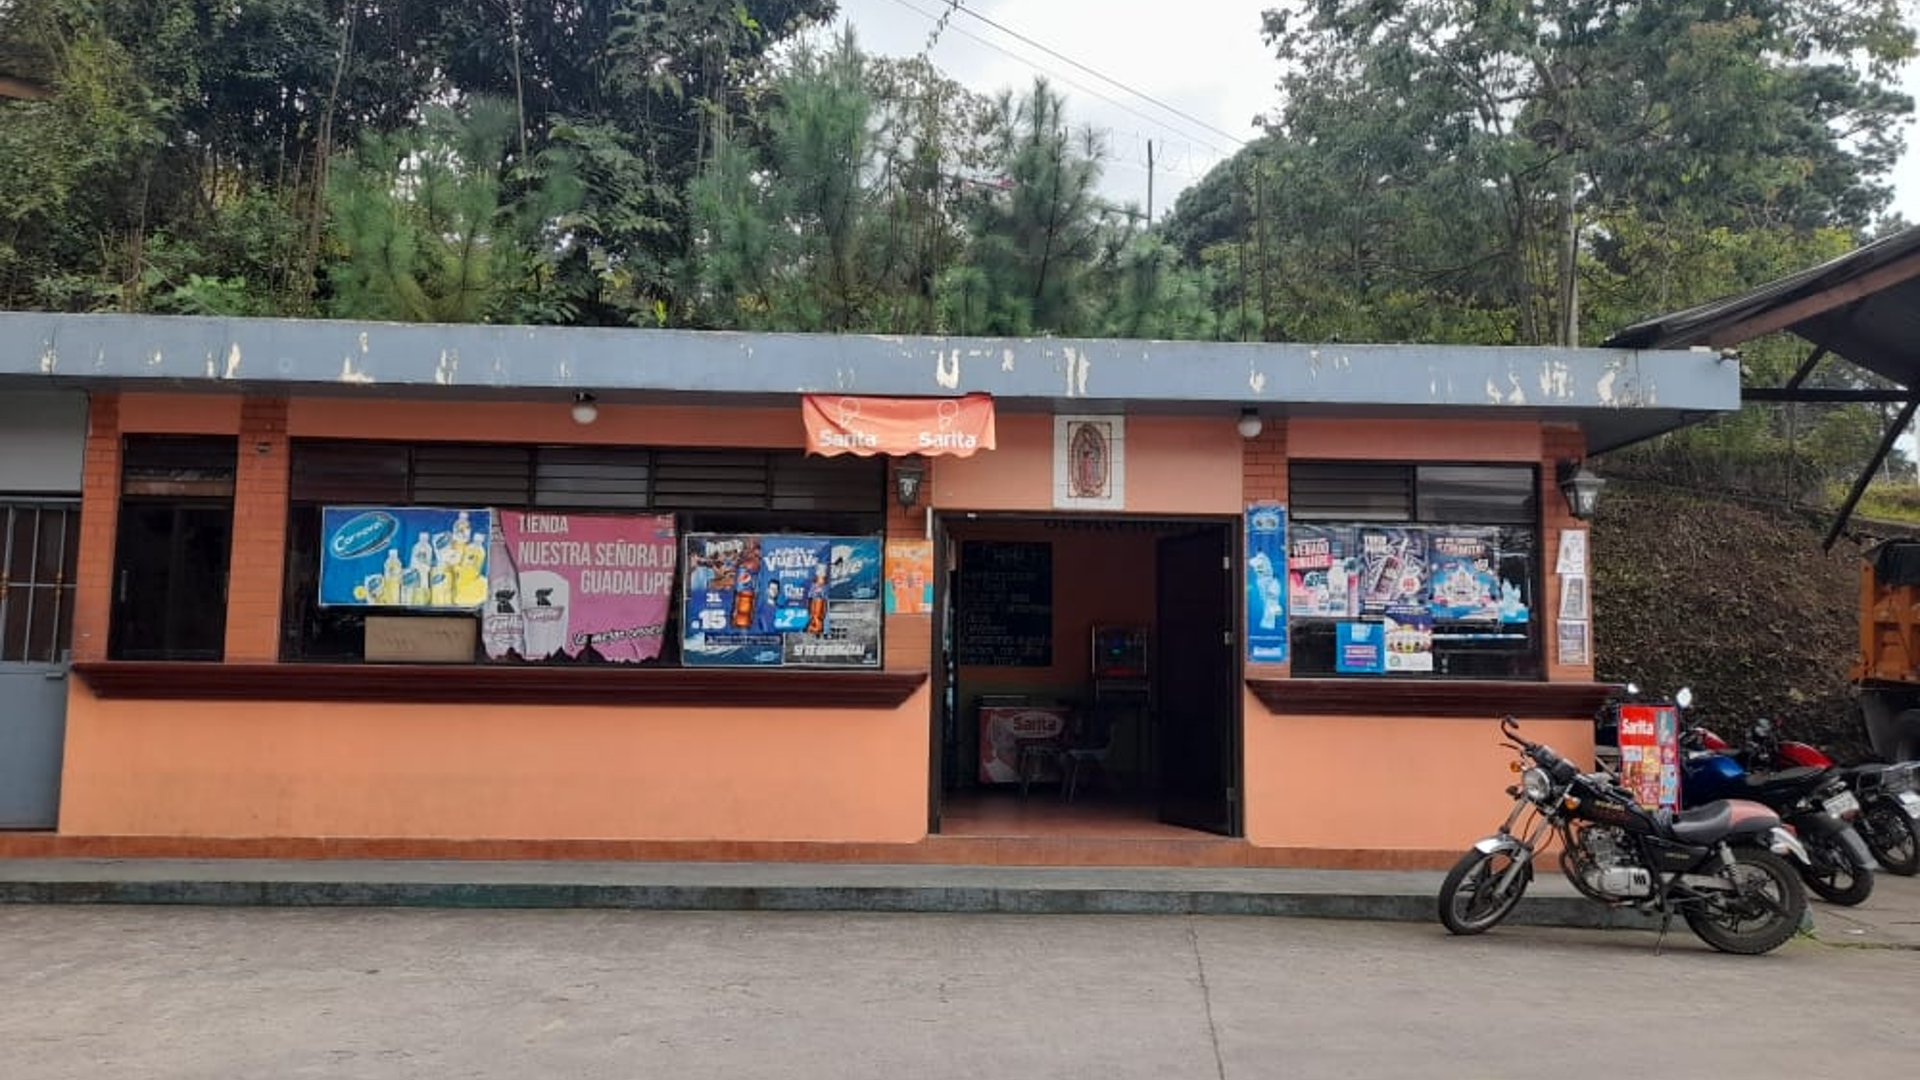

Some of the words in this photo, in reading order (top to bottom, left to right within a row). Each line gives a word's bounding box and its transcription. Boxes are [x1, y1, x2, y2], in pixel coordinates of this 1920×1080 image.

[819, 429, 876, 447] Sarita
[918, 431, 977, 448] Sarita
[519, 515, 569, 534] TIENDA
[517, 541, 591, 566] NUESTRA
[595, 539, 657, 568] SEÑORA
[580, 570, 674, 595] GUADALUPE
[1621, 718, 1655, 735] Sarita
